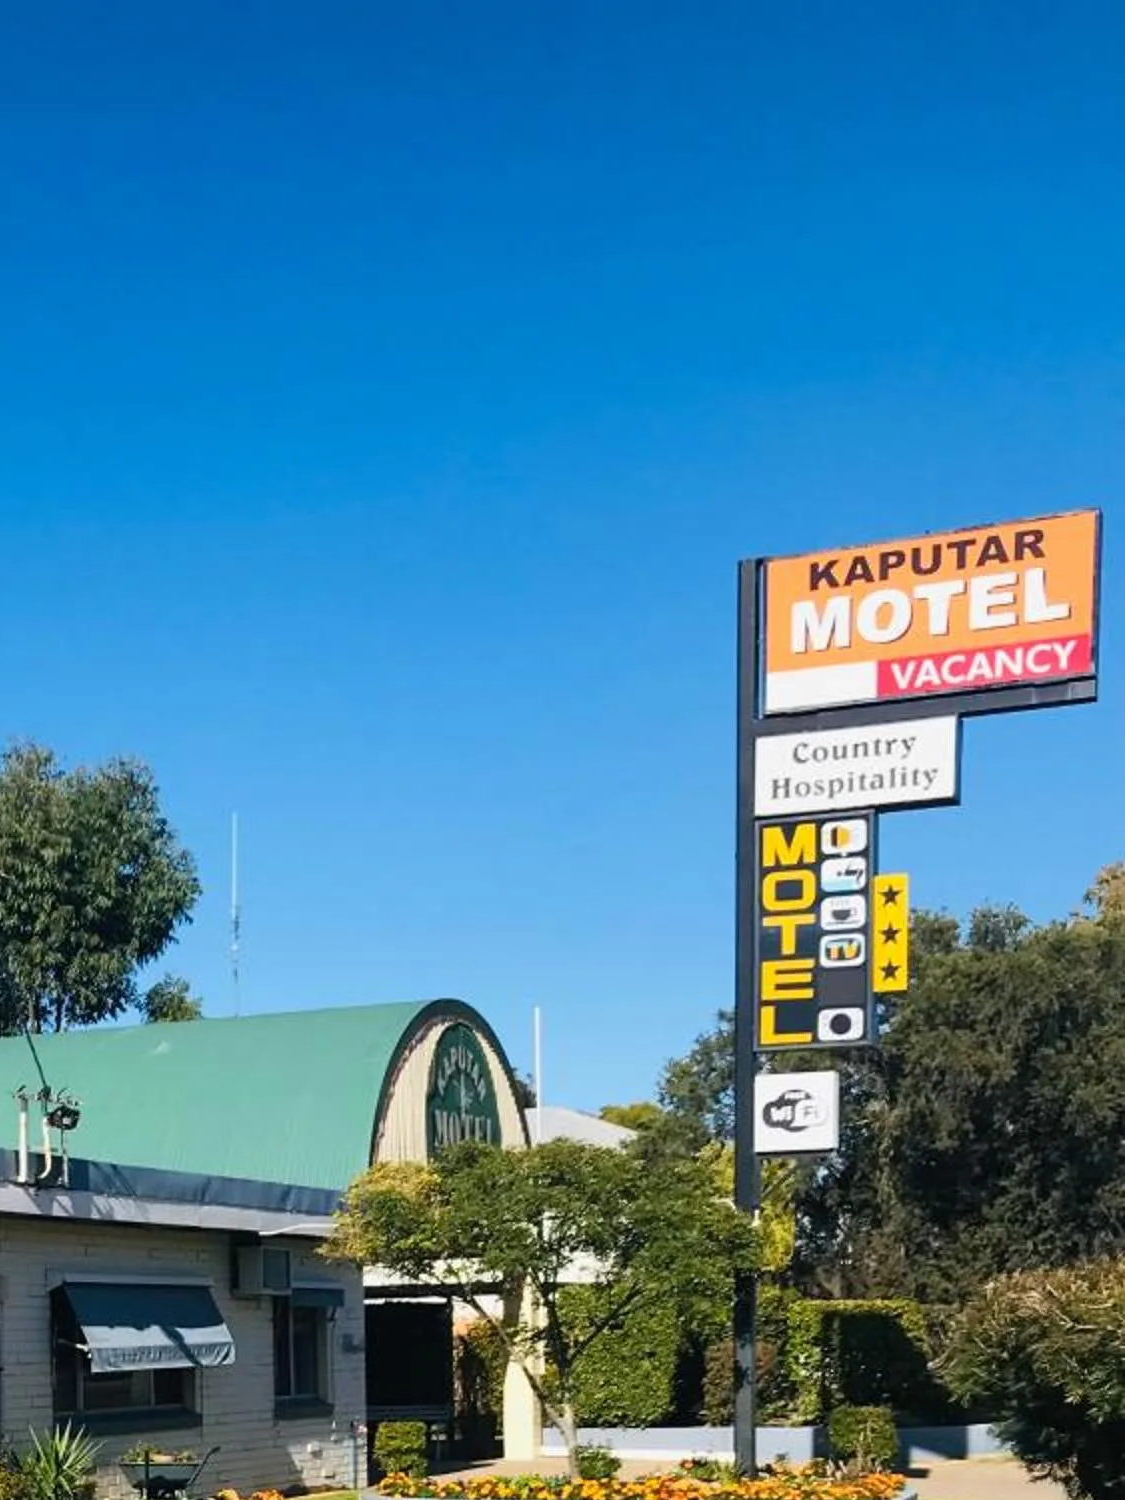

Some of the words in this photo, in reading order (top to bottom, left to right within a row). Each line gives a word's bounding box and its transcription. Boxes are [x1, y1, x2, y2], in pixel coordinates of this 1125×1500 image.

[808, 529, 1046, 591] KAPUTAR
[790, 567, 1072, 654] MOTEL
[891, 640, 1077, 690] VACANCY
[792, 736, 917, 764] Country
[771, 767, 939, 800] Hospitality
[760, 823, 817, 1045] MOTEL
